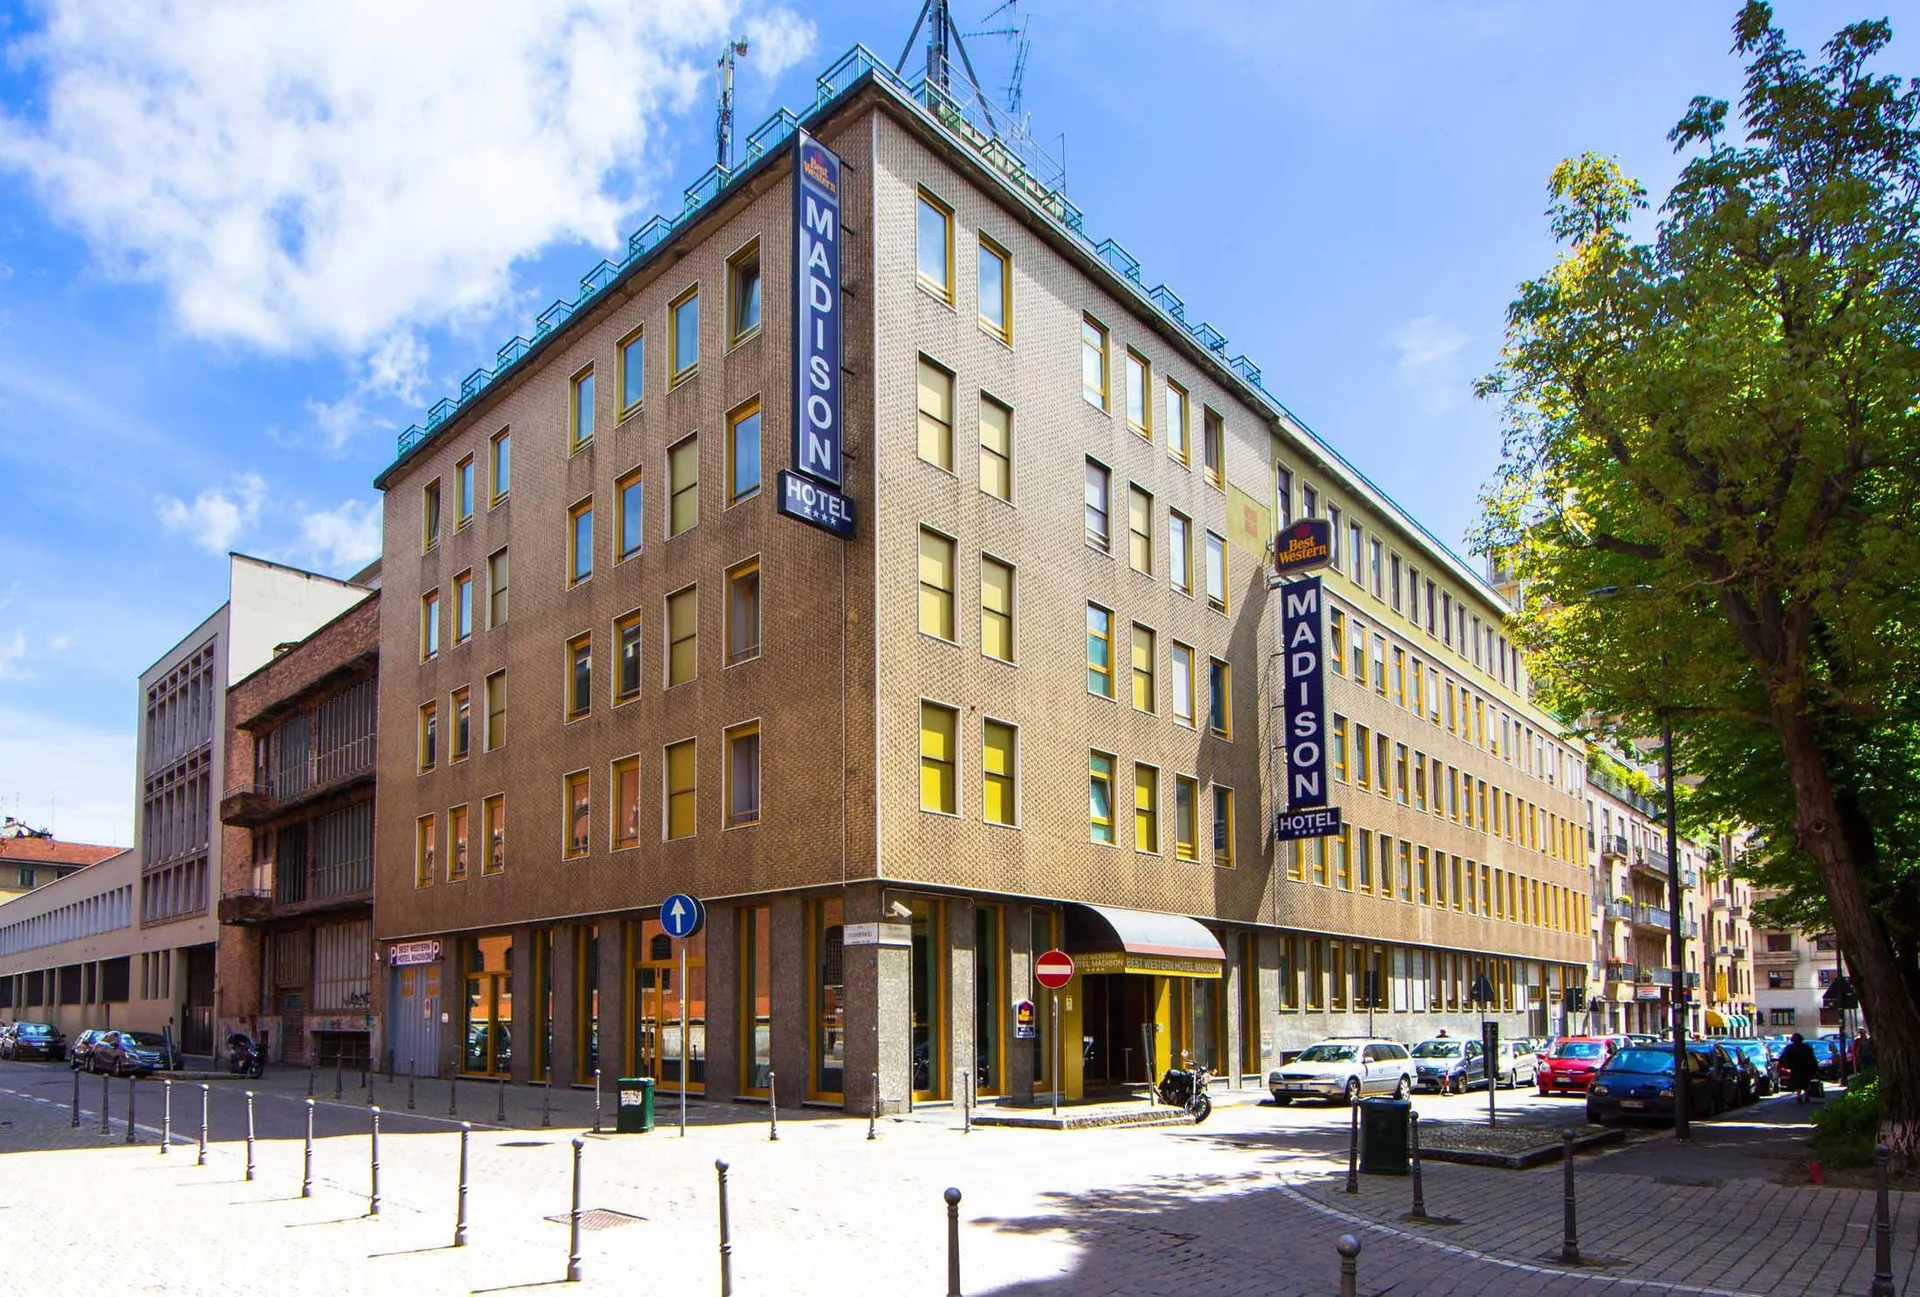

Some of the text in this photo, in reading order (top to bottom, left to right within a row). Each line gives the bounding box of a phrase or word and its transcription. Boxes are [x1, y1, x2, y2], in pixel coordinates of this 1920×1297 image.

[803, 160, 836, 193] Western
[810, 156, 829, 178] Best
[806, 196, 833, 470] MADISON
[787, 476, 852, 522] HOTEL
[1289, 535, 1316, 552] Best
[1279, 544, 1327, 565] Western
[1287, 588, 1320, 799] MADISON
[1280, 812, 1337, 831] HOTEL
[391, 947, 396, 963] P
[433, 942, 439, 960] P
[1073, 959, 1123, 968] OTEL MADISON
[1126, 957, 1222, 973] BEST WESTERN HOTEL MADISON
